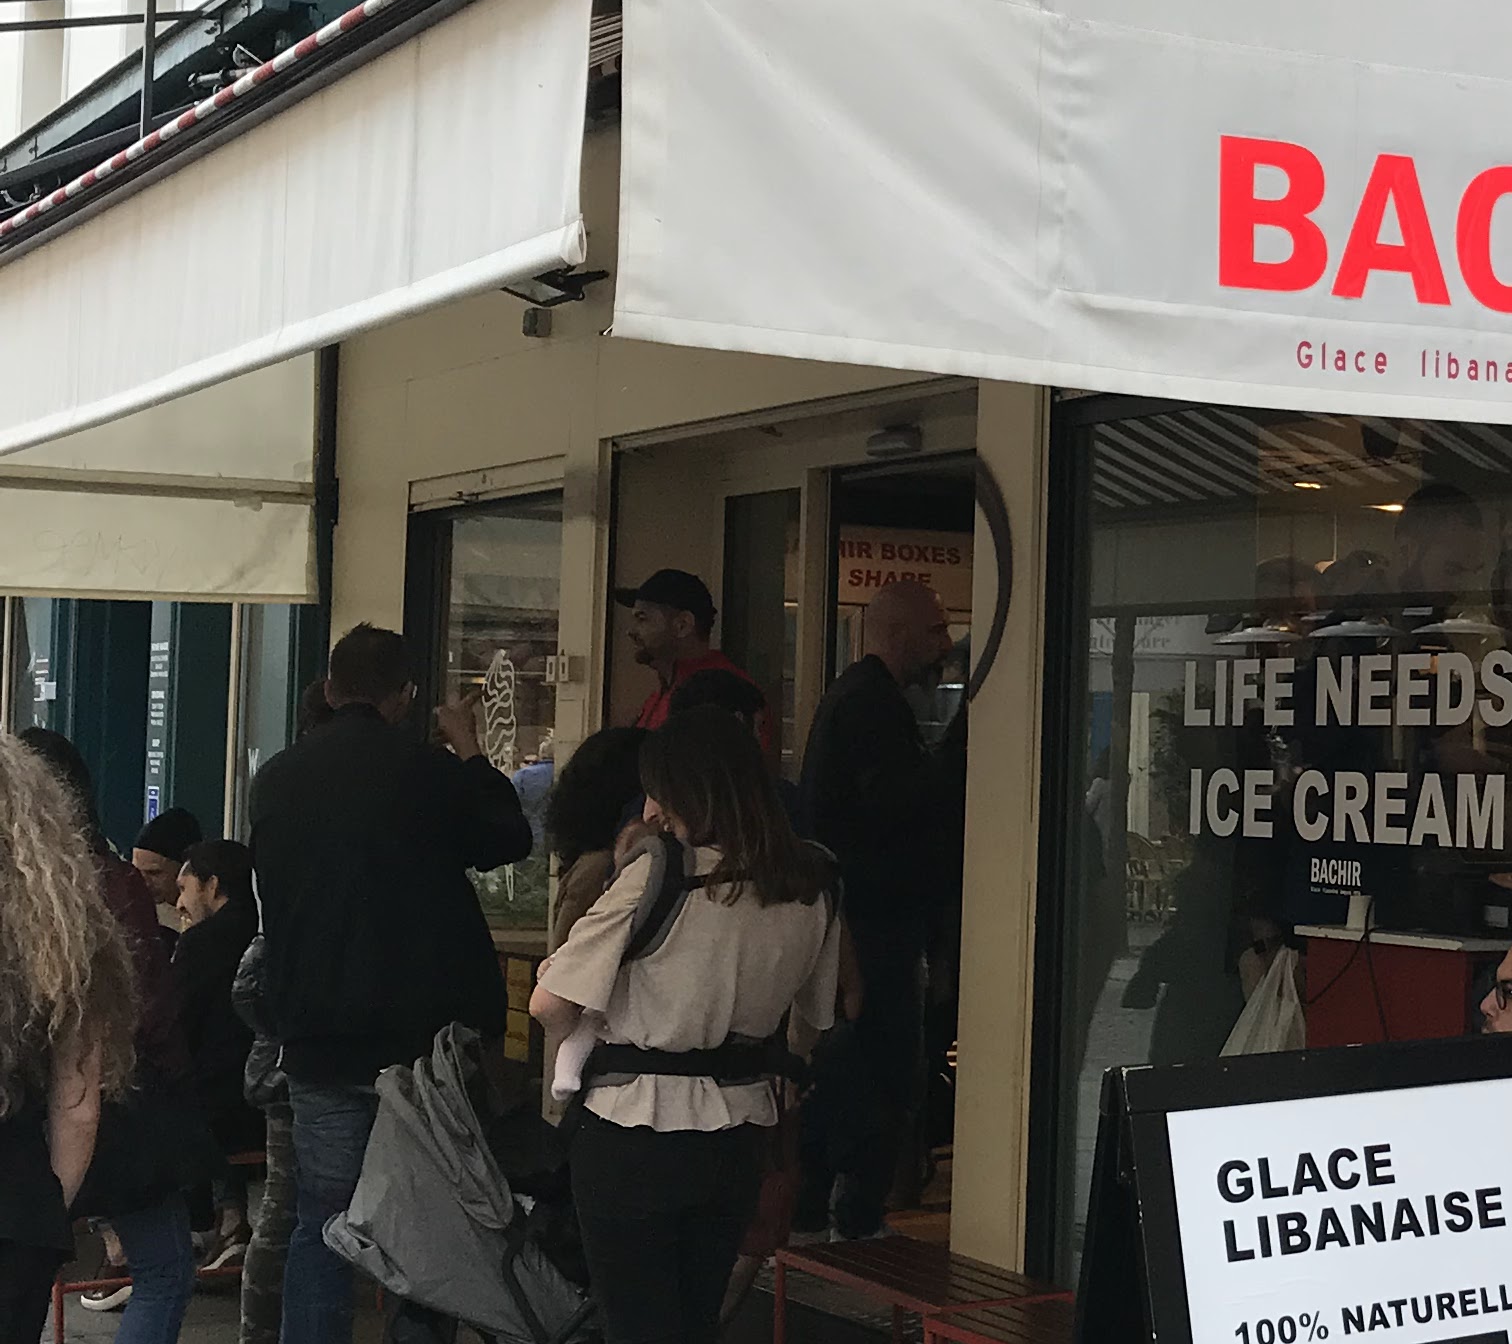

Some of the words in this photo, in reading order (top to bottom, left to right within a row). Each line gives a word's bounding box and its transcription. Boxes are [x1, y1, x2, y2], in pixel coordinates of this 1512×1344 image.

[1296, 340, 1388, 375] Glace
[882, 543, 961, 565] BOXES
[1183, 658, 1295, 727] LIFE
[1188, 767, 1275, 839] ICE
[1292, 768, 1505, 850] CREAM
[1310, 858, 1361, 886] BACHIR
[1217, 1143, 1396, 1203] GLACE
[1223, 1187, 1506, 1263] LIBANAISE
